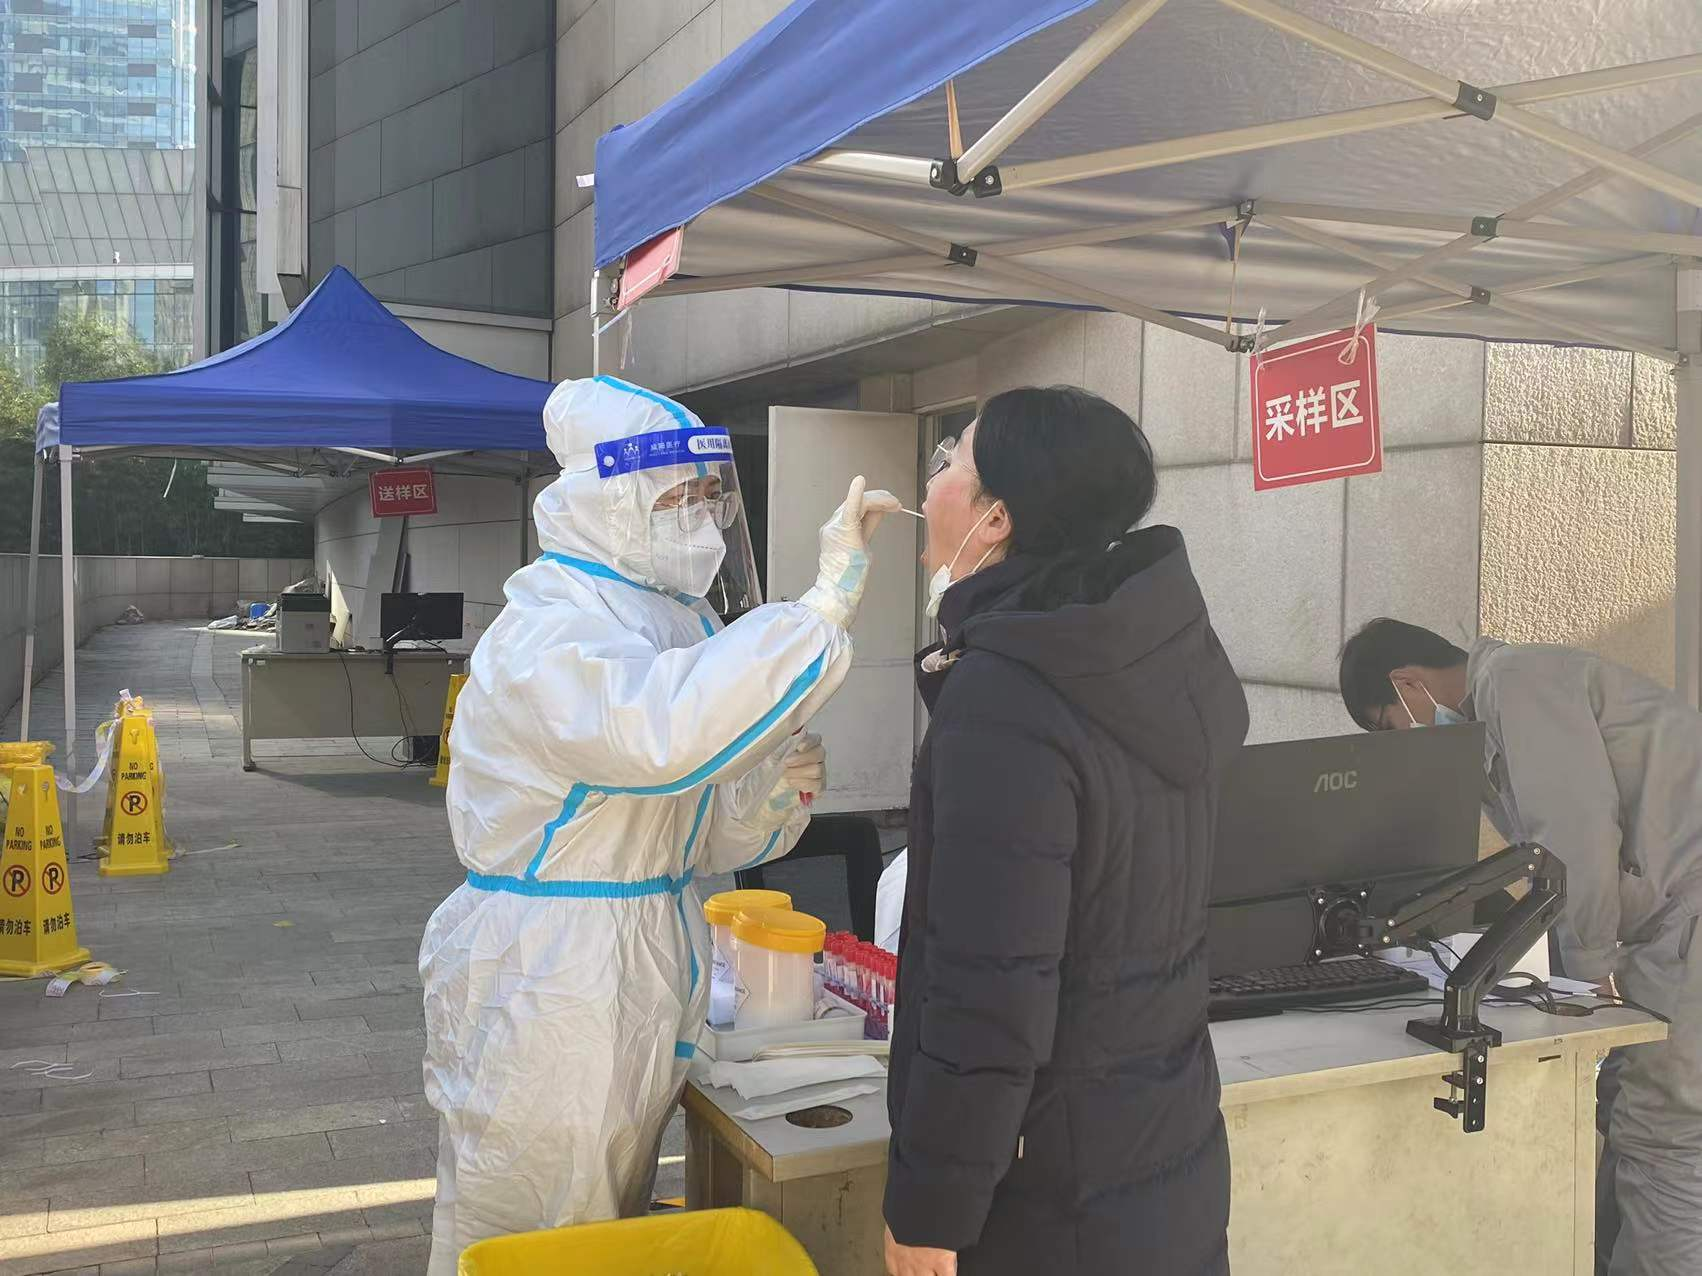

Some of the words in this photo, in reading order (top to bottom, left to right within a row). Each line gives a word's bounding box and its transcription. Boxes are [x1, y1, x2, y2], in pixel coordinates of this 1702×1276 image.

[1265, 379, 1364, 441] 采样区
[378, 484, 429, 501] 送样区
[128, 762, 138, 770] NO
[121, 771, 147, 780] PARKING
[1313, 770, 1357, 793] AOC
[15, 826, 25, 838] NO
[45, 824, 54, 835] NO
[6, 839, 32, 851] PARKING
[40, 835, 61, 851] PARKING
[117, 831, 151, 846] 请勿泊车
[42, 912, 71, 935] 请勿泊车
